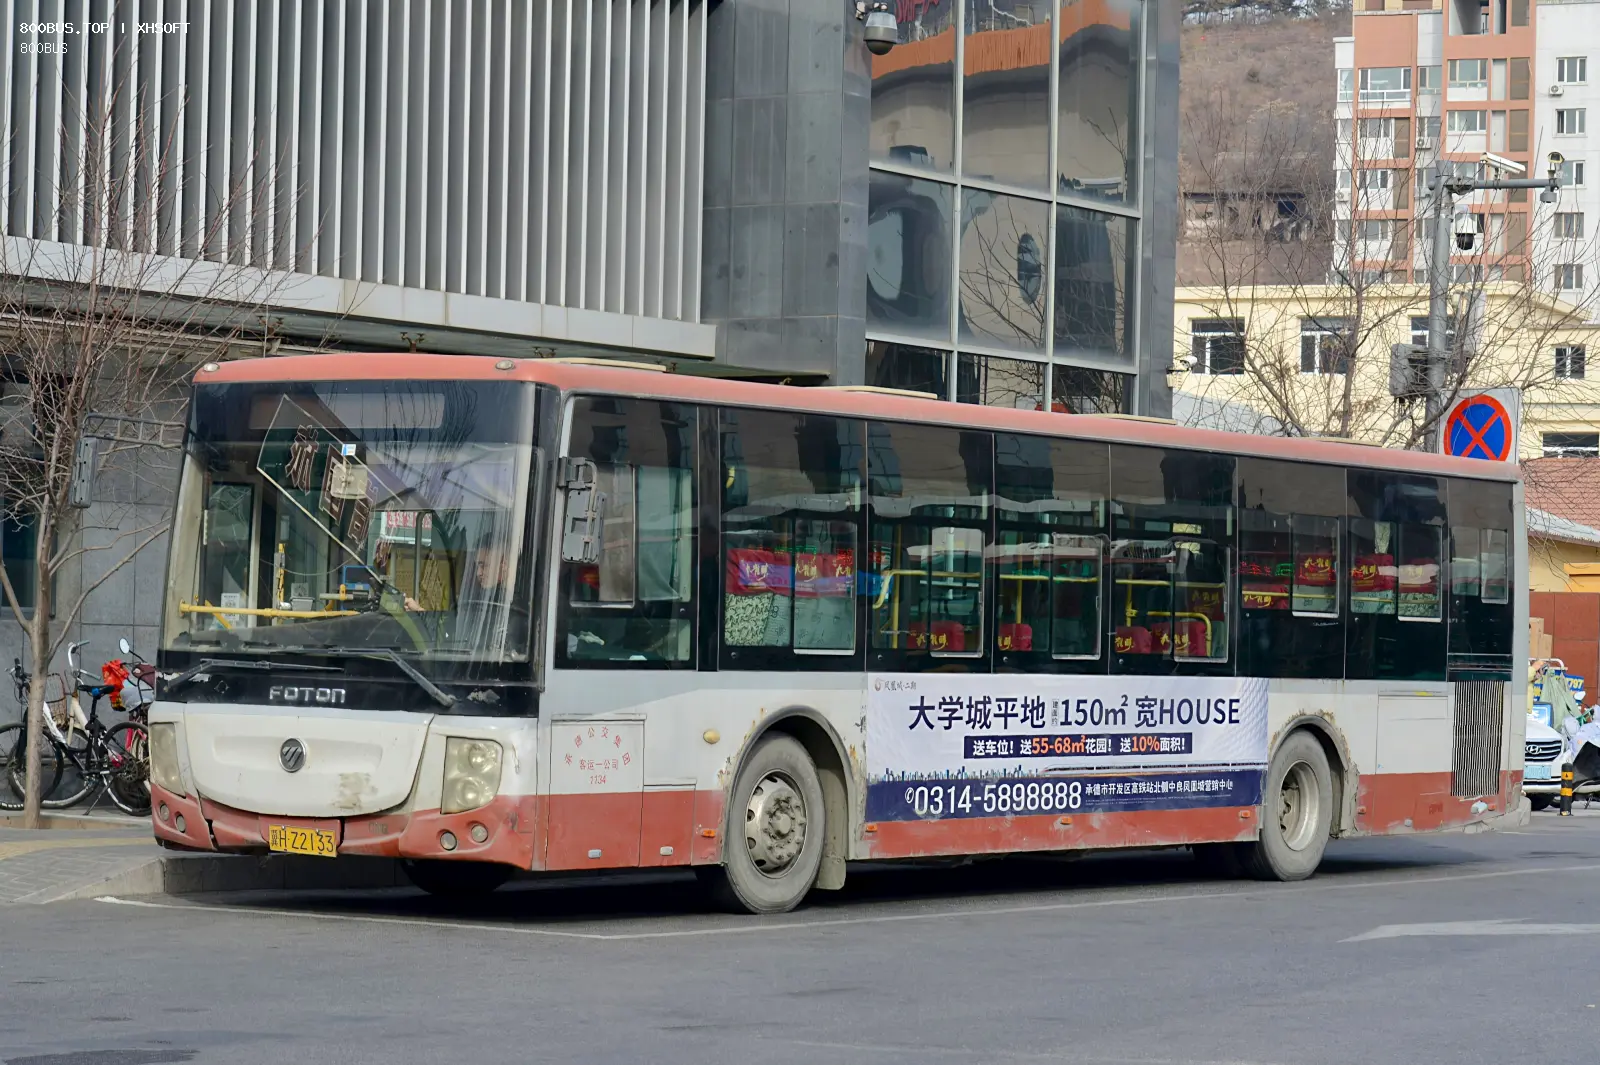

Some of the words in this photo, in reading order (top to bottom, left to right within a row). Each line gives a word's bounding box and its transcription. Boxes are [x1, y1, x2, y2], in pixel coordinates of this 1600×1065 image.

[269, 686, 346, 703] FOTON
[908, 695, 1046, 731] 大学城平地
[914, 781, 1082, 815] 0314-5898888
